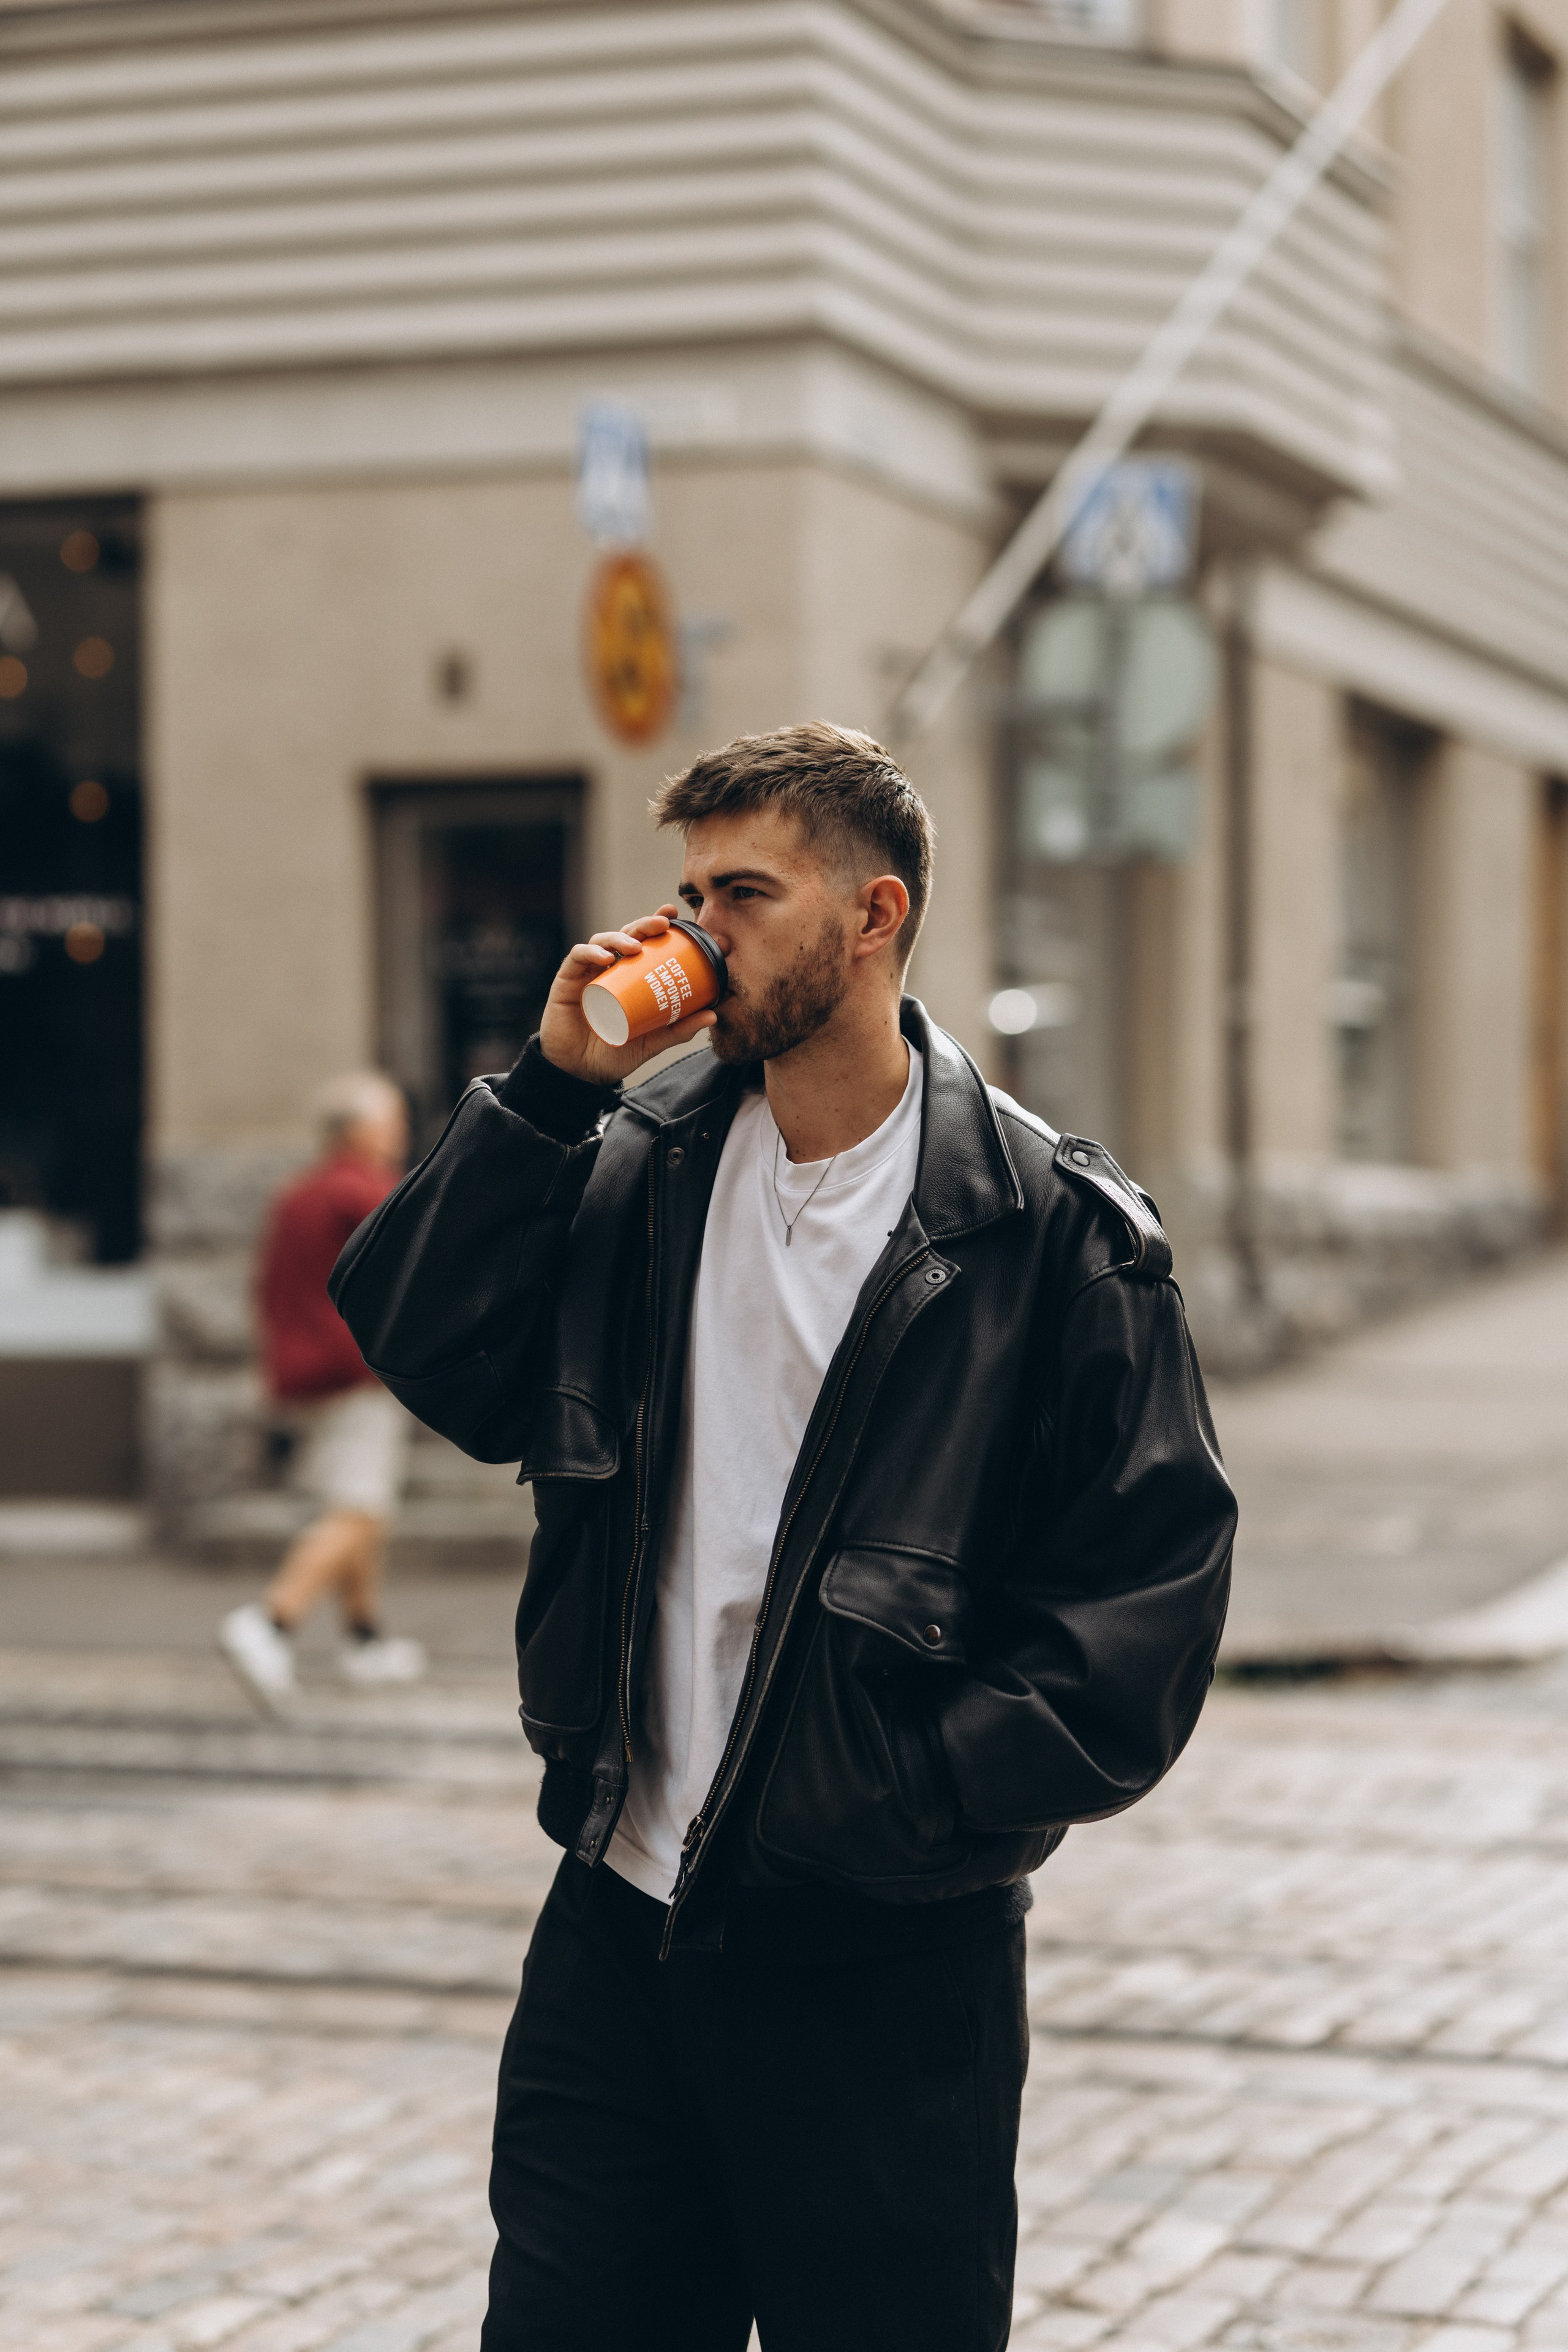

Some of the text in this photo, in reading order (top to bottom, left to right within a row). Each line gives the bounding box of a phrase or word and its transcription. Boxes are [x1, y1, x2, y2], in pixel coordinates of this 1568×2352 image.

[644, 971, 669, 1011] WOMEN
[654, 964, 681, 1026] EMPOWERIN
[665, 957, 692, 1000] COFFEE
